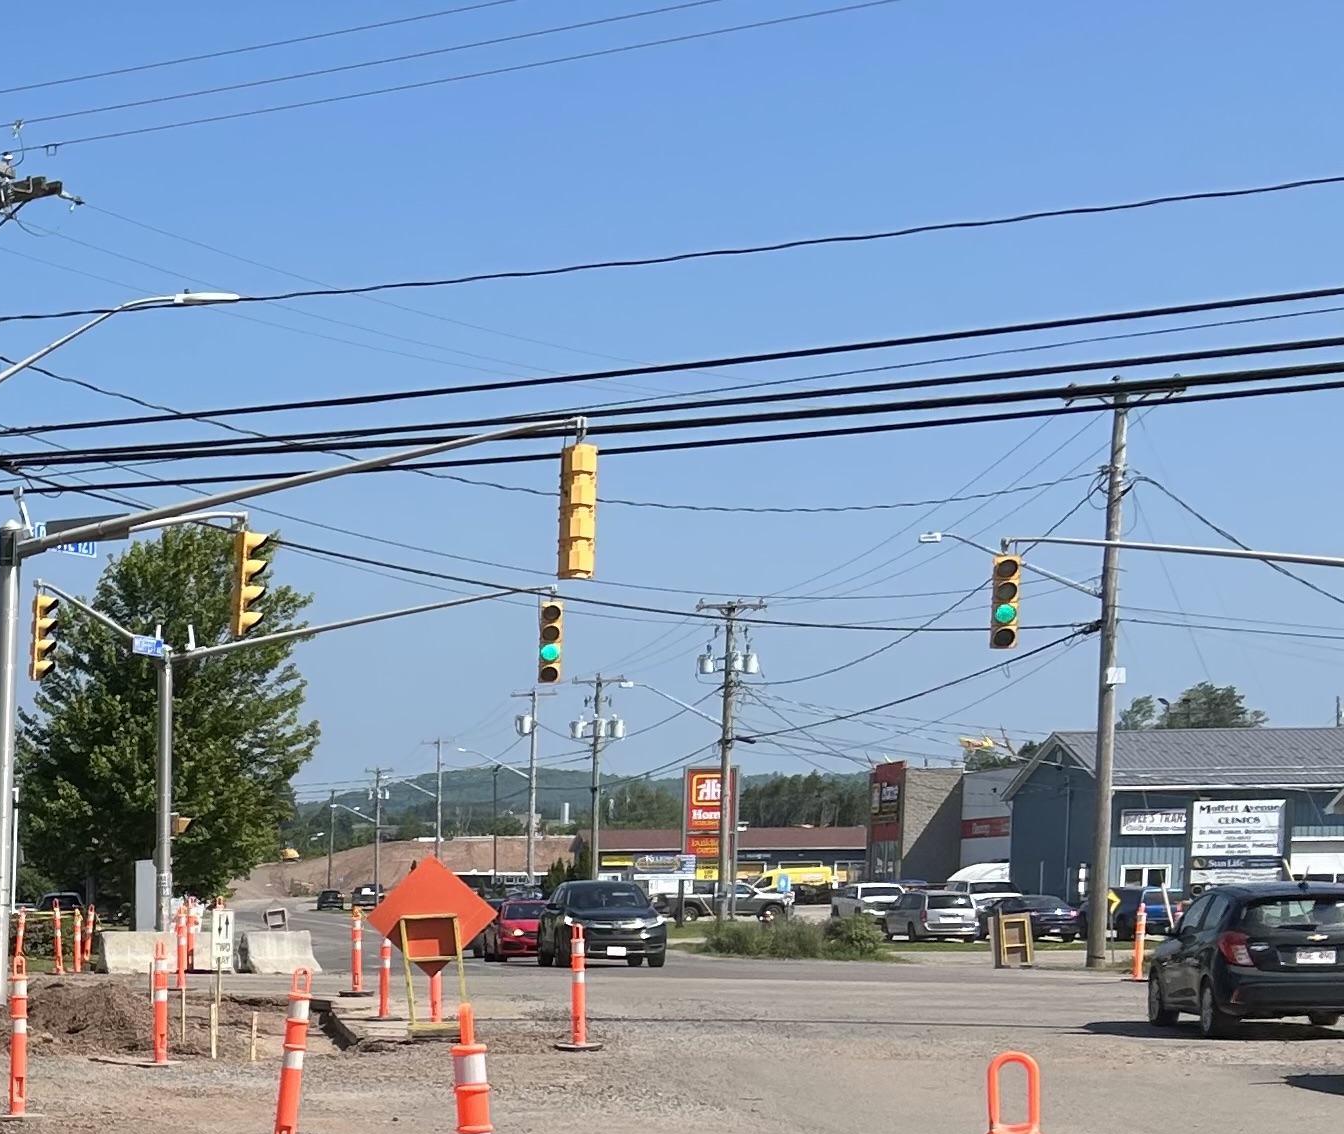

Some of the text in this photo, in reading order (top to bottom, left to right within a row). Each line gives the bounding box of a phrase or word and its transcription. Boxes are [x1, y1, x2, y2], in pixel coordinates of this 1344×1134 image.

[1199, 804, 1281, 814] Moffett Avenue
[691, 809, 721, 820] Hom
[1217, 816, 1261, 825] CLINICS
[1208, 859, 1227, 868] Sun
[1227, 858, 1246, 867] Life
[216, 943, 230, 952] TWO
